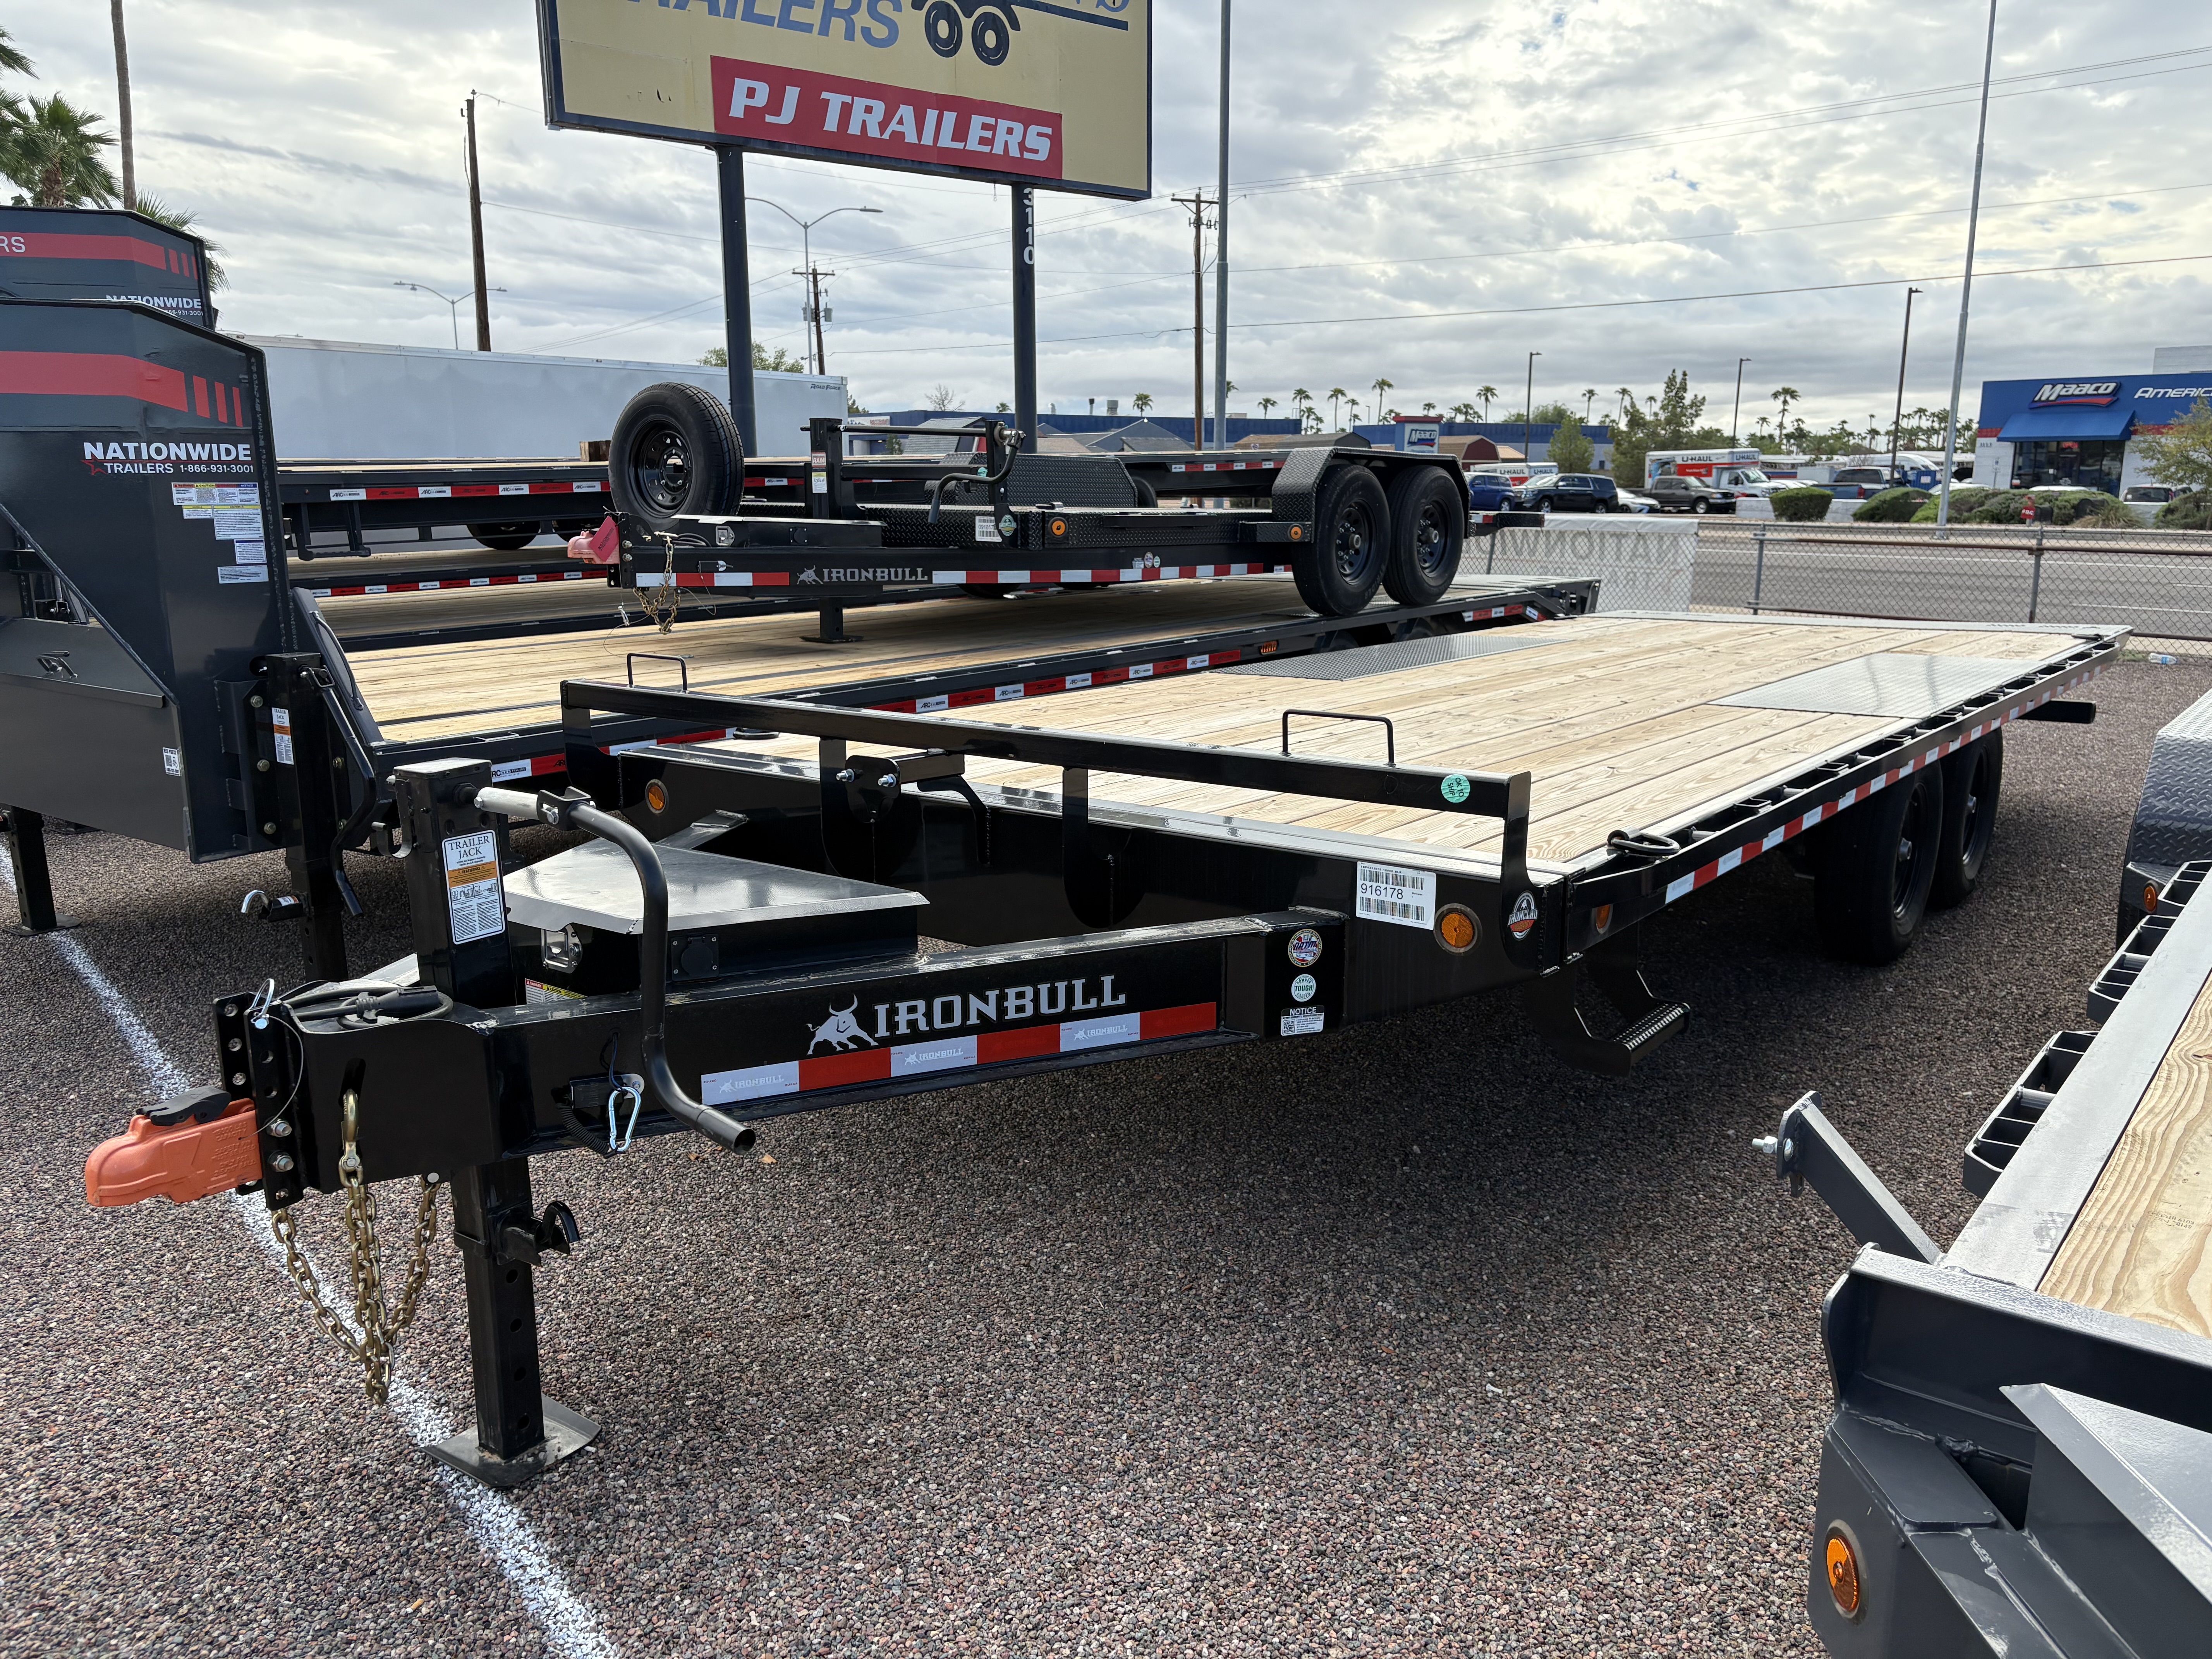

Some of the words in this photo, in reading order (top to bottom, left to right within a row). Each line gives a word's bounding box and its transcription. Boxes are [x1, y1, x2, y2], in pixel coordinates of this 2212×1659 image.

[729, 77, 801, 125] PJ
[819, 91, 1053, 161] TRAILERS
[2033, 382, 2118, 402] Maaco
[2134, 387, 2212, 399] AMERIC
[1408, 429, 1437, 443] Maaco
[84, 442, 252, 460] NATIONWIDE
[104, 463, 174, 474] TRAILERS
[180, 464, 254, 473] 1-866-931-3001
[823, 568, 928, 582] IRONBULL
[1455, 778, 1462, 788] OK
[1457, 788, 1465, 797] TO
[448, 835, 490, 850] TRAILER
[459, 847, 483, 860] JACK
[1361, 883, 1403, 900] 916178
[1508, 908, 1538, 926] IRONCLAD
[1293, 940, 1317, 950] NATM
[874, 974, 1127, 1038] IRONBULL
[1290, 1006, 1317, 1015] NOTICE
[1087, 1025, 1128, 1037] IRONBULL
[919, 1048, 963, 1061] IRONBULL
[734, 1075, 784, 1089] IRONBULL
